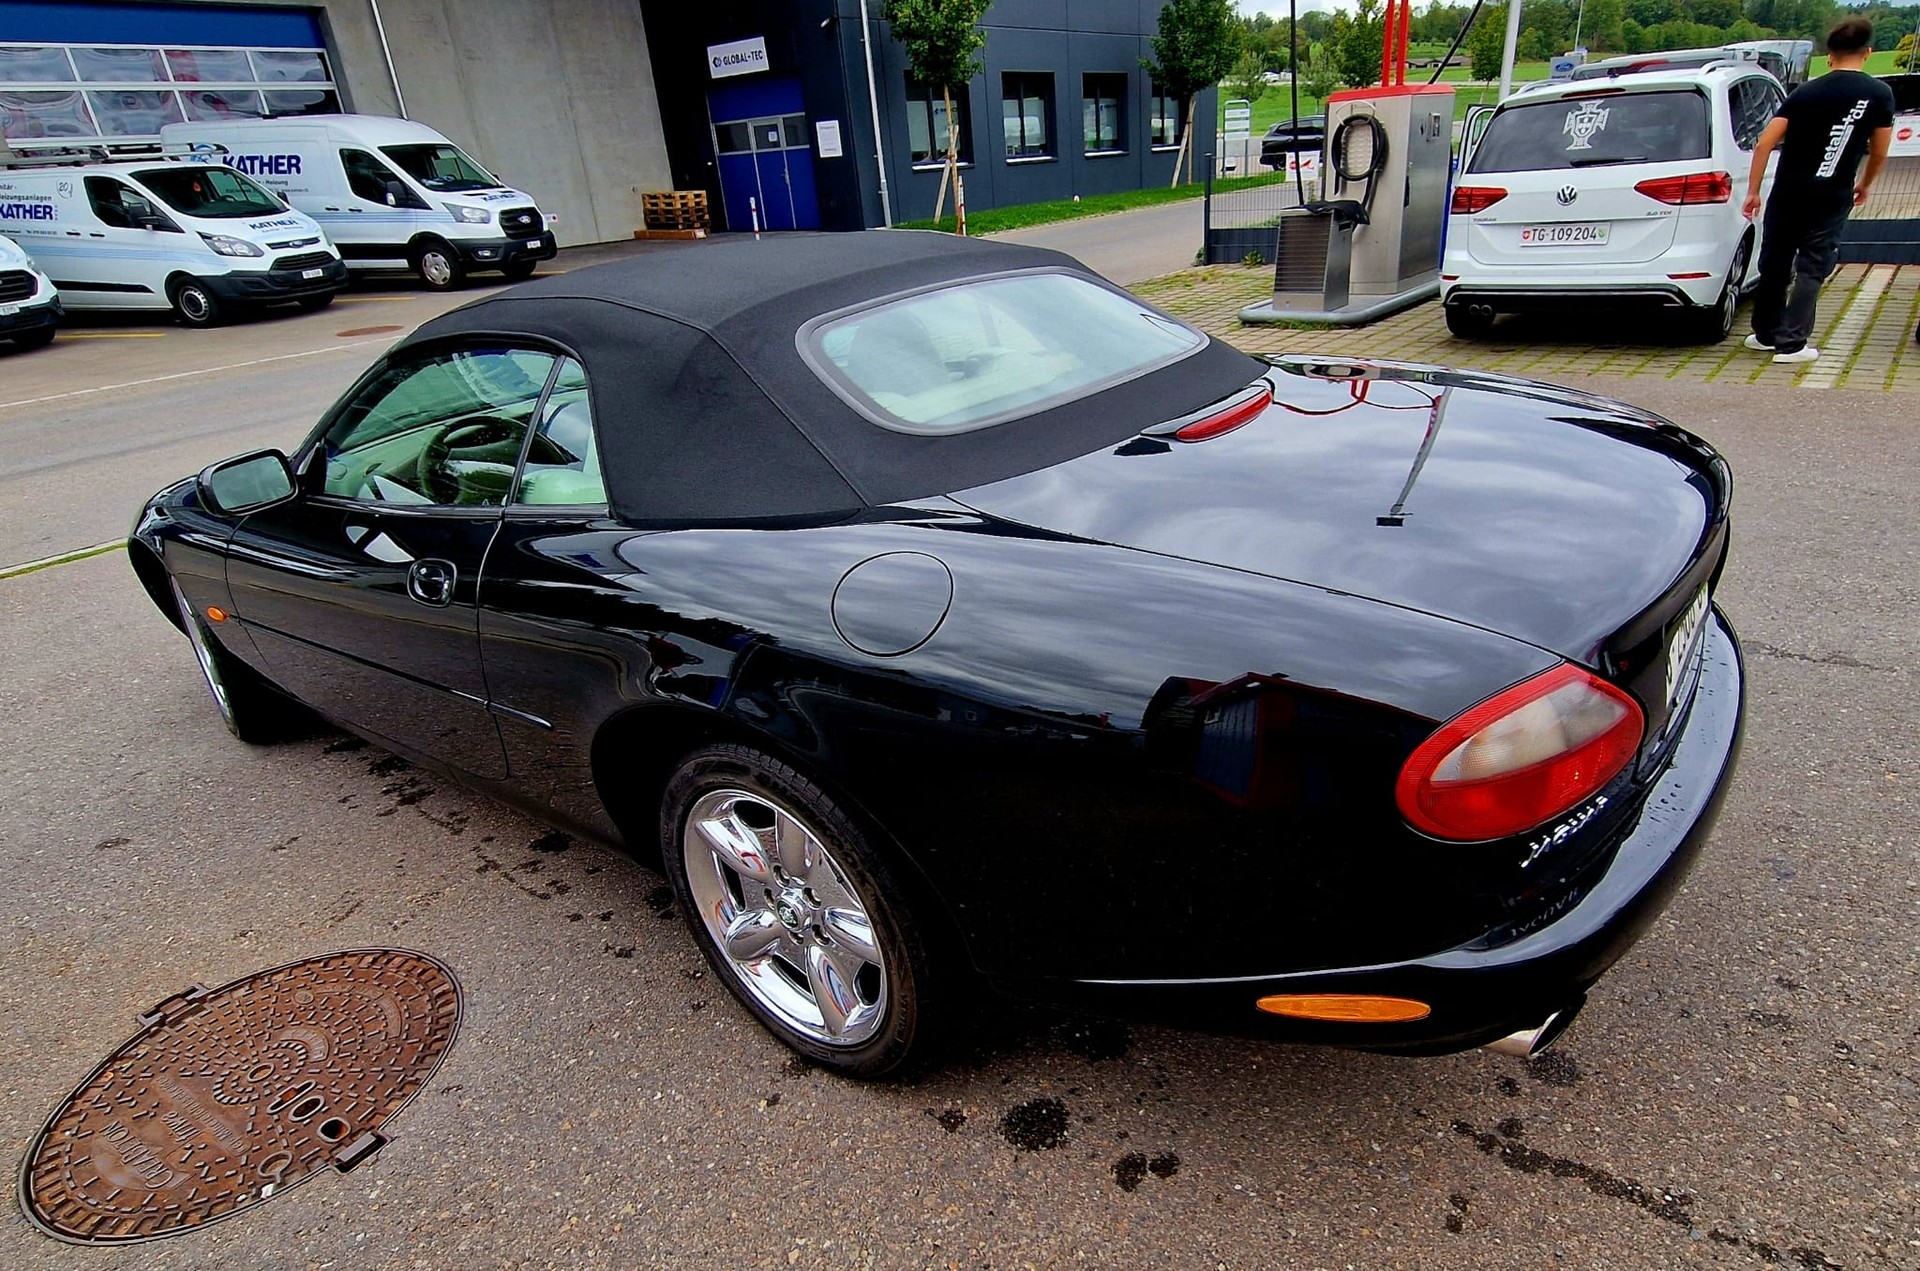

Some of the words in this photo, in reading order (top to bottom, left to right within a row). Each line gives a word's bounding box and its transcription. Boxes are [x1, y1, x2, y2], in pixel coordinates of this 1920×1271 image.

[723, 50, 763, 66] GLOBAL-TEC
[222, 154, 301, 175] KATHER
[0, 194, 53, 202] eizungsanlagen
[0, 203, 54, 220] KATHER
[248, 219, 299, 230] KATHER
